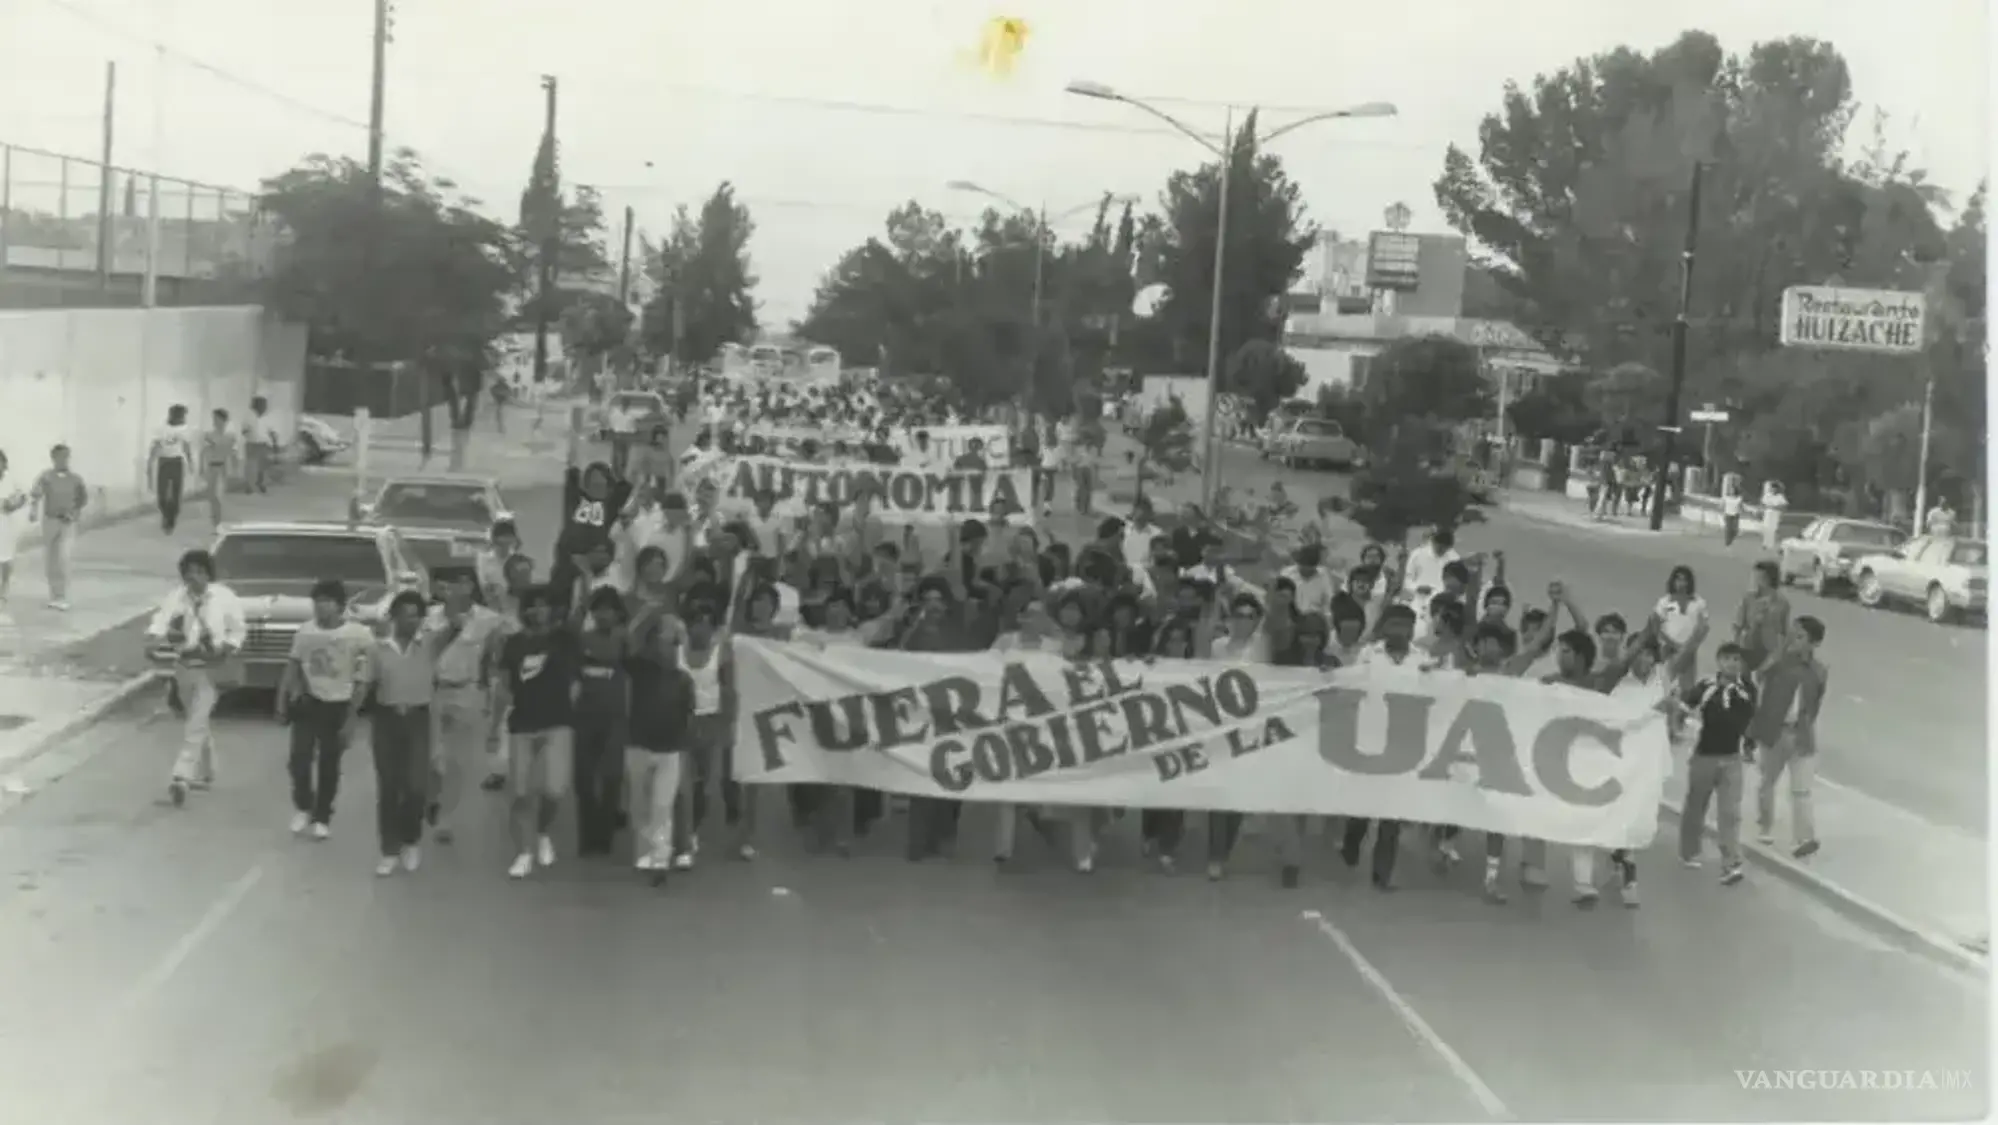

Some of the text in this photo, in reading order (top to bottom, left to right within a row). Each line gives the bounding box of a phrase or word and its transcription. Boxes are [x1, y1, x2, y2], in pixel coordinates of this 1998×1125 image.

[1796, 316, 1917, 346] HUIZACHE
[752, 655, 1142, 773] FUERA EL
[929, 669, 1258, 792] GOBIERNO
[1154, 716, 1297, 782] DE LA
[1312, 686, 1623, 807] UAC
